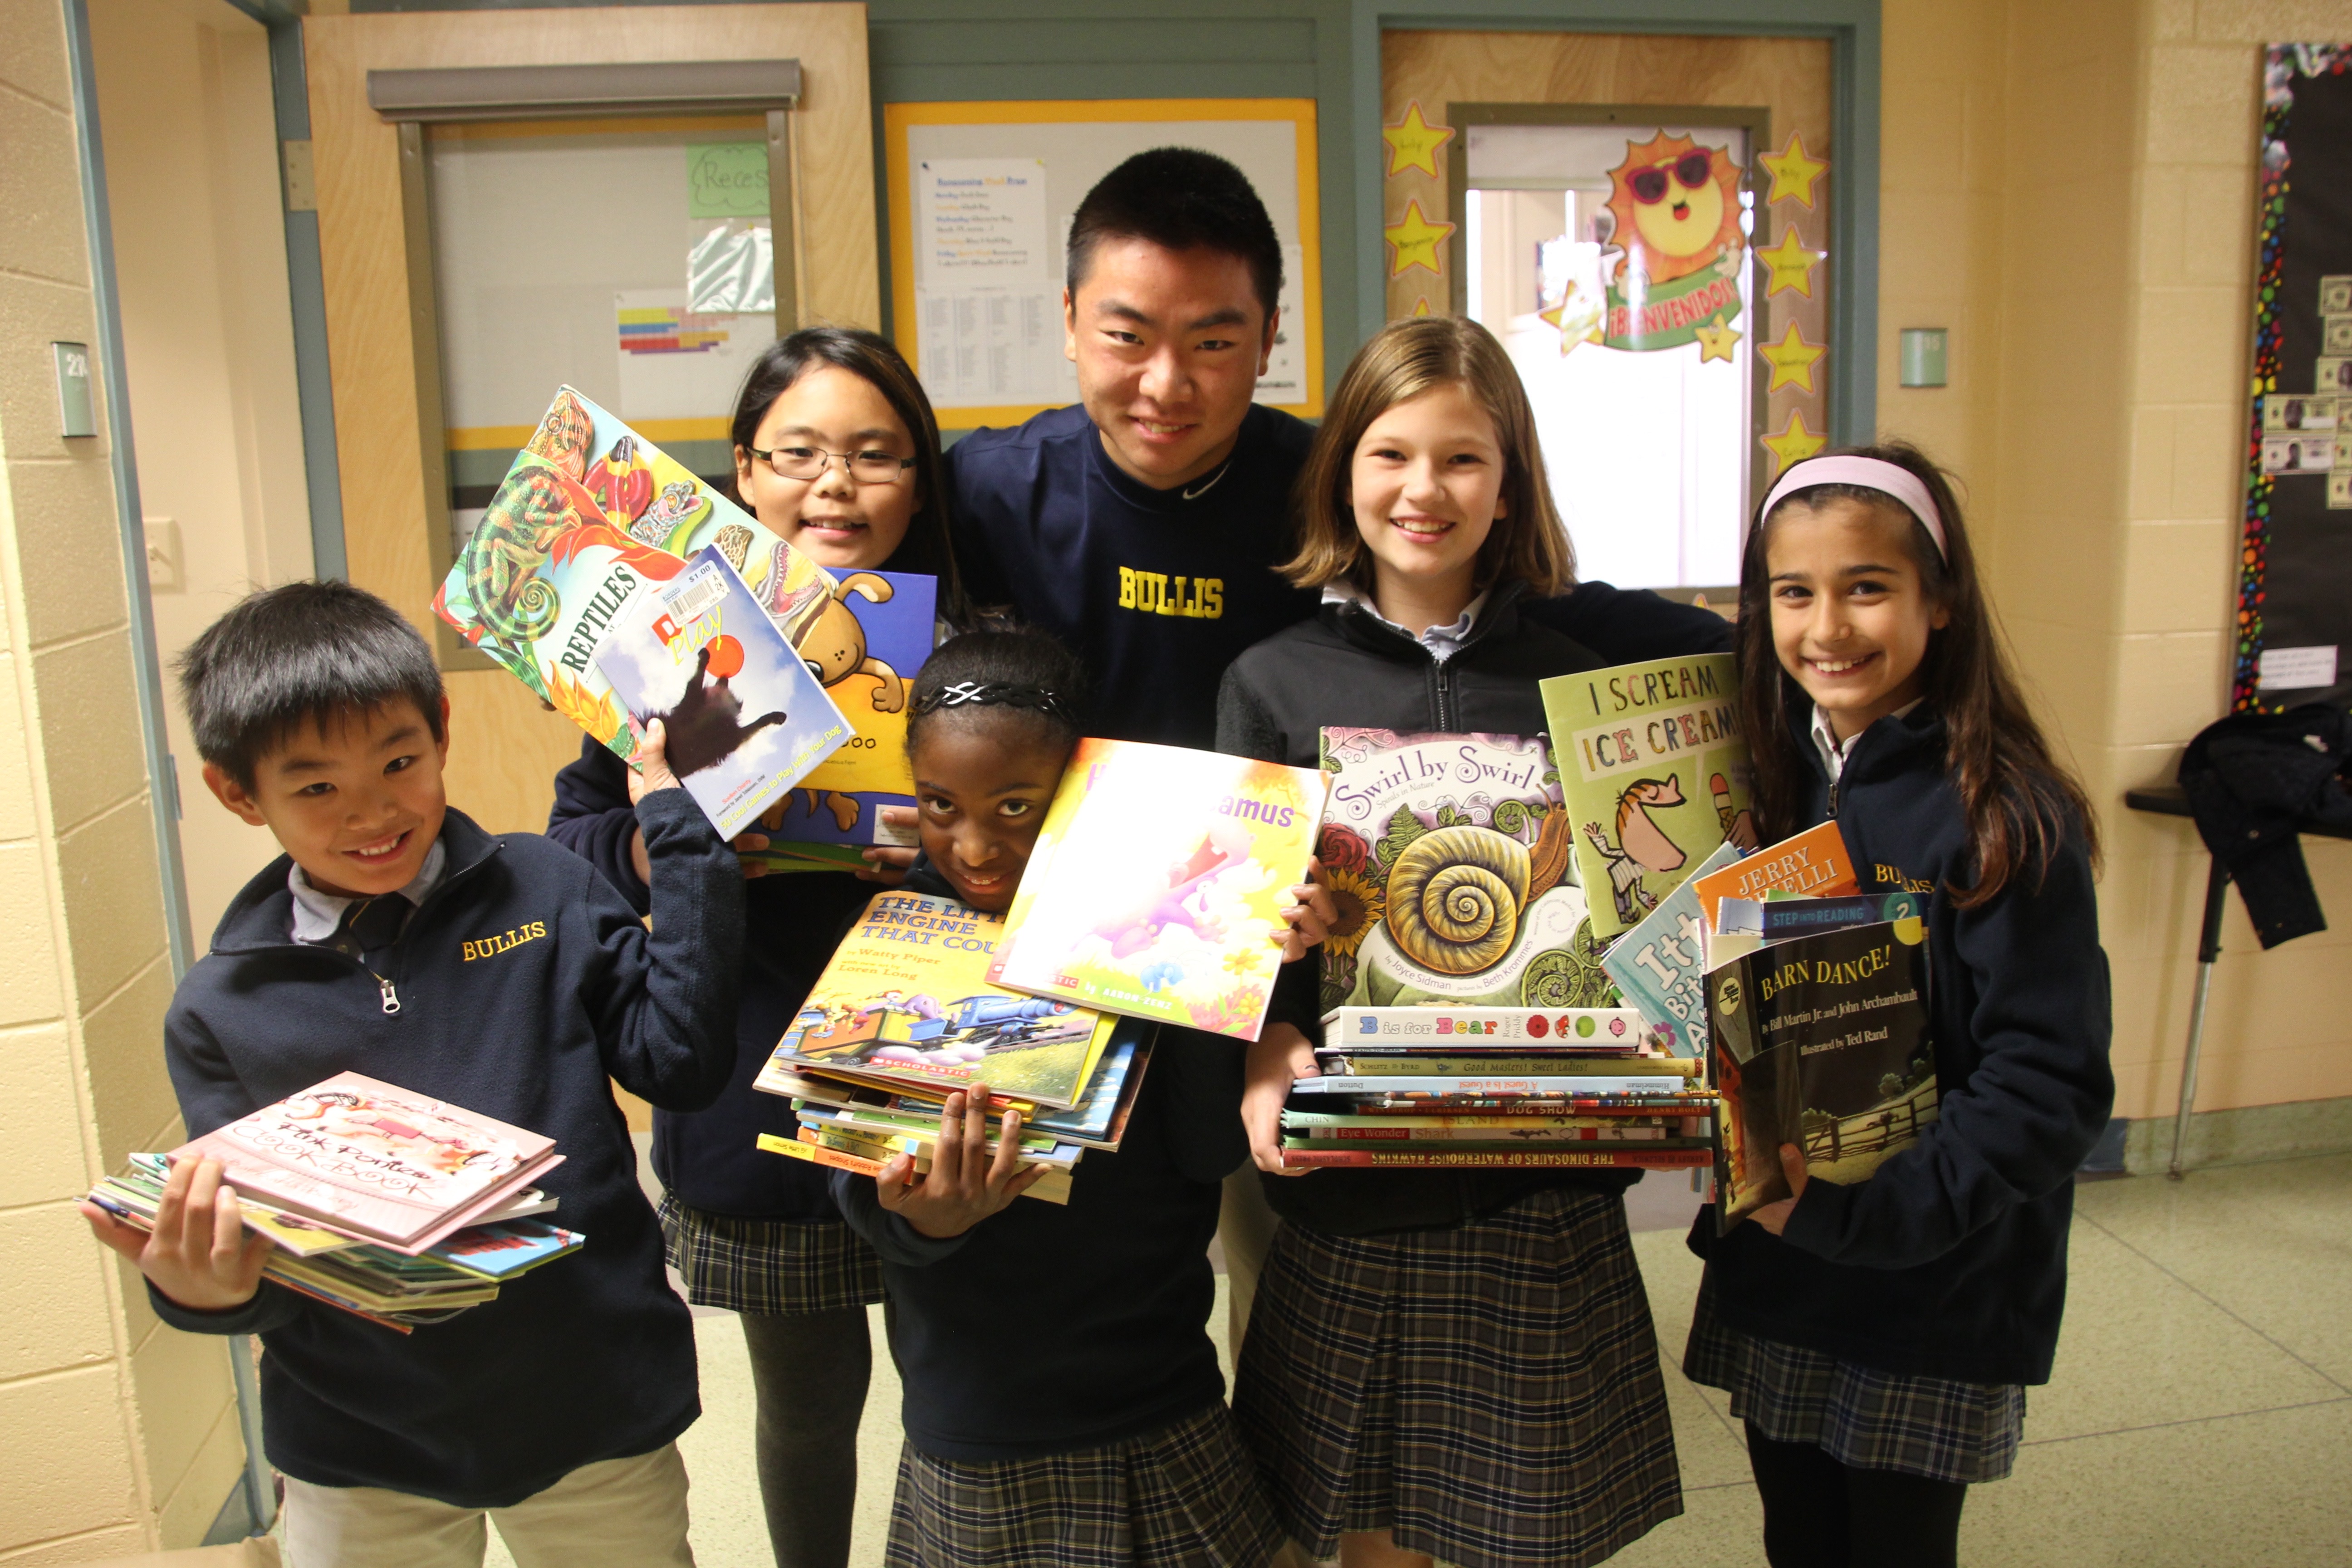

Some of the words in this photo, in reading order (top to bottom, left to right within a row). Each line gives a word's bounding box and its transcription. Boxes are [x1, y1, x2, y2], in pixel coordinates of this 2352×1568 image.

[689, 564, 711, 583] $1.00
[1118, 566, 1224, 619] BULLIS
[560, 565, 636, 674] REPTILES
[666, 605, 722, 666] Play
[1589, 682, 1601, 715] I
[1609, 665, 1720, 711] SCREAM
[1583, 728, 1639, 772] ICE
[720, 817, 732, 830] 50
[730, 804, 747, 822] Cool
[745, 787, 771, 809] Games
[769, 779, 779, 789] to
[776, 766, 794, 782] Play
[809, 736, 826, 754] Your
[824, 725, 843, 741] Dog
[1335, 755, 1414, 821] Swirl
[1414, 749, 1450, 781] by
[1455, 745, 1536, 790] Swirl
[1376, 791, 1400, 810] Spirals
[1401, 789, 1409, 797] in
[1409, 780, 1435, 792] Nature
[1739, 847, 1810, 896] JERRY
[879, 896, 936, 914] THE
[941, 904, 1005, 924] LITT
[1773, 912, 1799, 927] STEP
[1815, 906, 1864, 924] READING
[1896, 902, 1910, 920] 2
[867, 911, 978, 936] ENGINE
[462, 921, 547, 961] BULLIS
[861, 925, 939, 945] THAT
[858, 948, 901, 960] Watty
[902, 953, 941, 965] Piper
[1482, 971, 1504, 988] Beth
[1502, 939, 1534, 975] Krommes
[838, 964, 879, 975] Loren
[882, 968, 919, 981] Long
[1392, 960, 1415, 980] Joyce
[1416, 973, 1451, 990] Sidman
[1760, 960, 1810, 1001] BARN
[1815, 944, 1891, 985] DANCE!
[1102, 987, 1140, 1004] AARON
[1142, 996, 1173, 1010] ZENZ
[1769, 1017, 1783, 1031] Bill
[1784, 1011, 1811, 1027] Martin
[1823, 1006, 1838, 1018] and
[1838, 1001, 1860, 1018] John
[1861, 988, 1918, 1011] Archambault
[1359, 1016, 1379, 1034] B
[1383, 1022, 1400, 1034] is
[1404, 1022, 1432, 1034] for
[1436, 1017, 1498, 1034] Bear
[1502, 1016, 1511, 1039] Roger
[1513, 1014, 1522, 1039] Priddy
[1845, 1031, 1863, 1047] Ted
[1864, 1025, 1888, 1043] Rand
[884, 1059, 969, 1078] SCHOLASTIC
[1464, 1061, 1486, 1072] Good
[1490, 1063, 1528, 1072] Masters!
[1531, 1063, 1553, 1073] Sweet
[1558, 1060, 1588, 1072] Ladies!
[1459, 1081, 1483, 1089] Guest
[1504, 1081, 1529, 1090] Guest
[1507, 1106, 1534, 1115] DOG
[1539, 1106, 1577, 1115] SHOW
[1341, 1128, 1361, 1138] Eye
[1364, 1128, 1406, 1137] Wonder
[1415, 1127, 1454, 1139] Shark
[829, 1155, 849, 1165] Shapes
[1371, 1152, 1426, 1165] HAWKINS
[1429, 1153, 1503, 1165] WATERHOUSE
[1507, 1153, 1524, 1165] OF
[1524, 1153, 1589, 1165] DINOSAURS
[1593, 1153, 1615, 1165] THE
